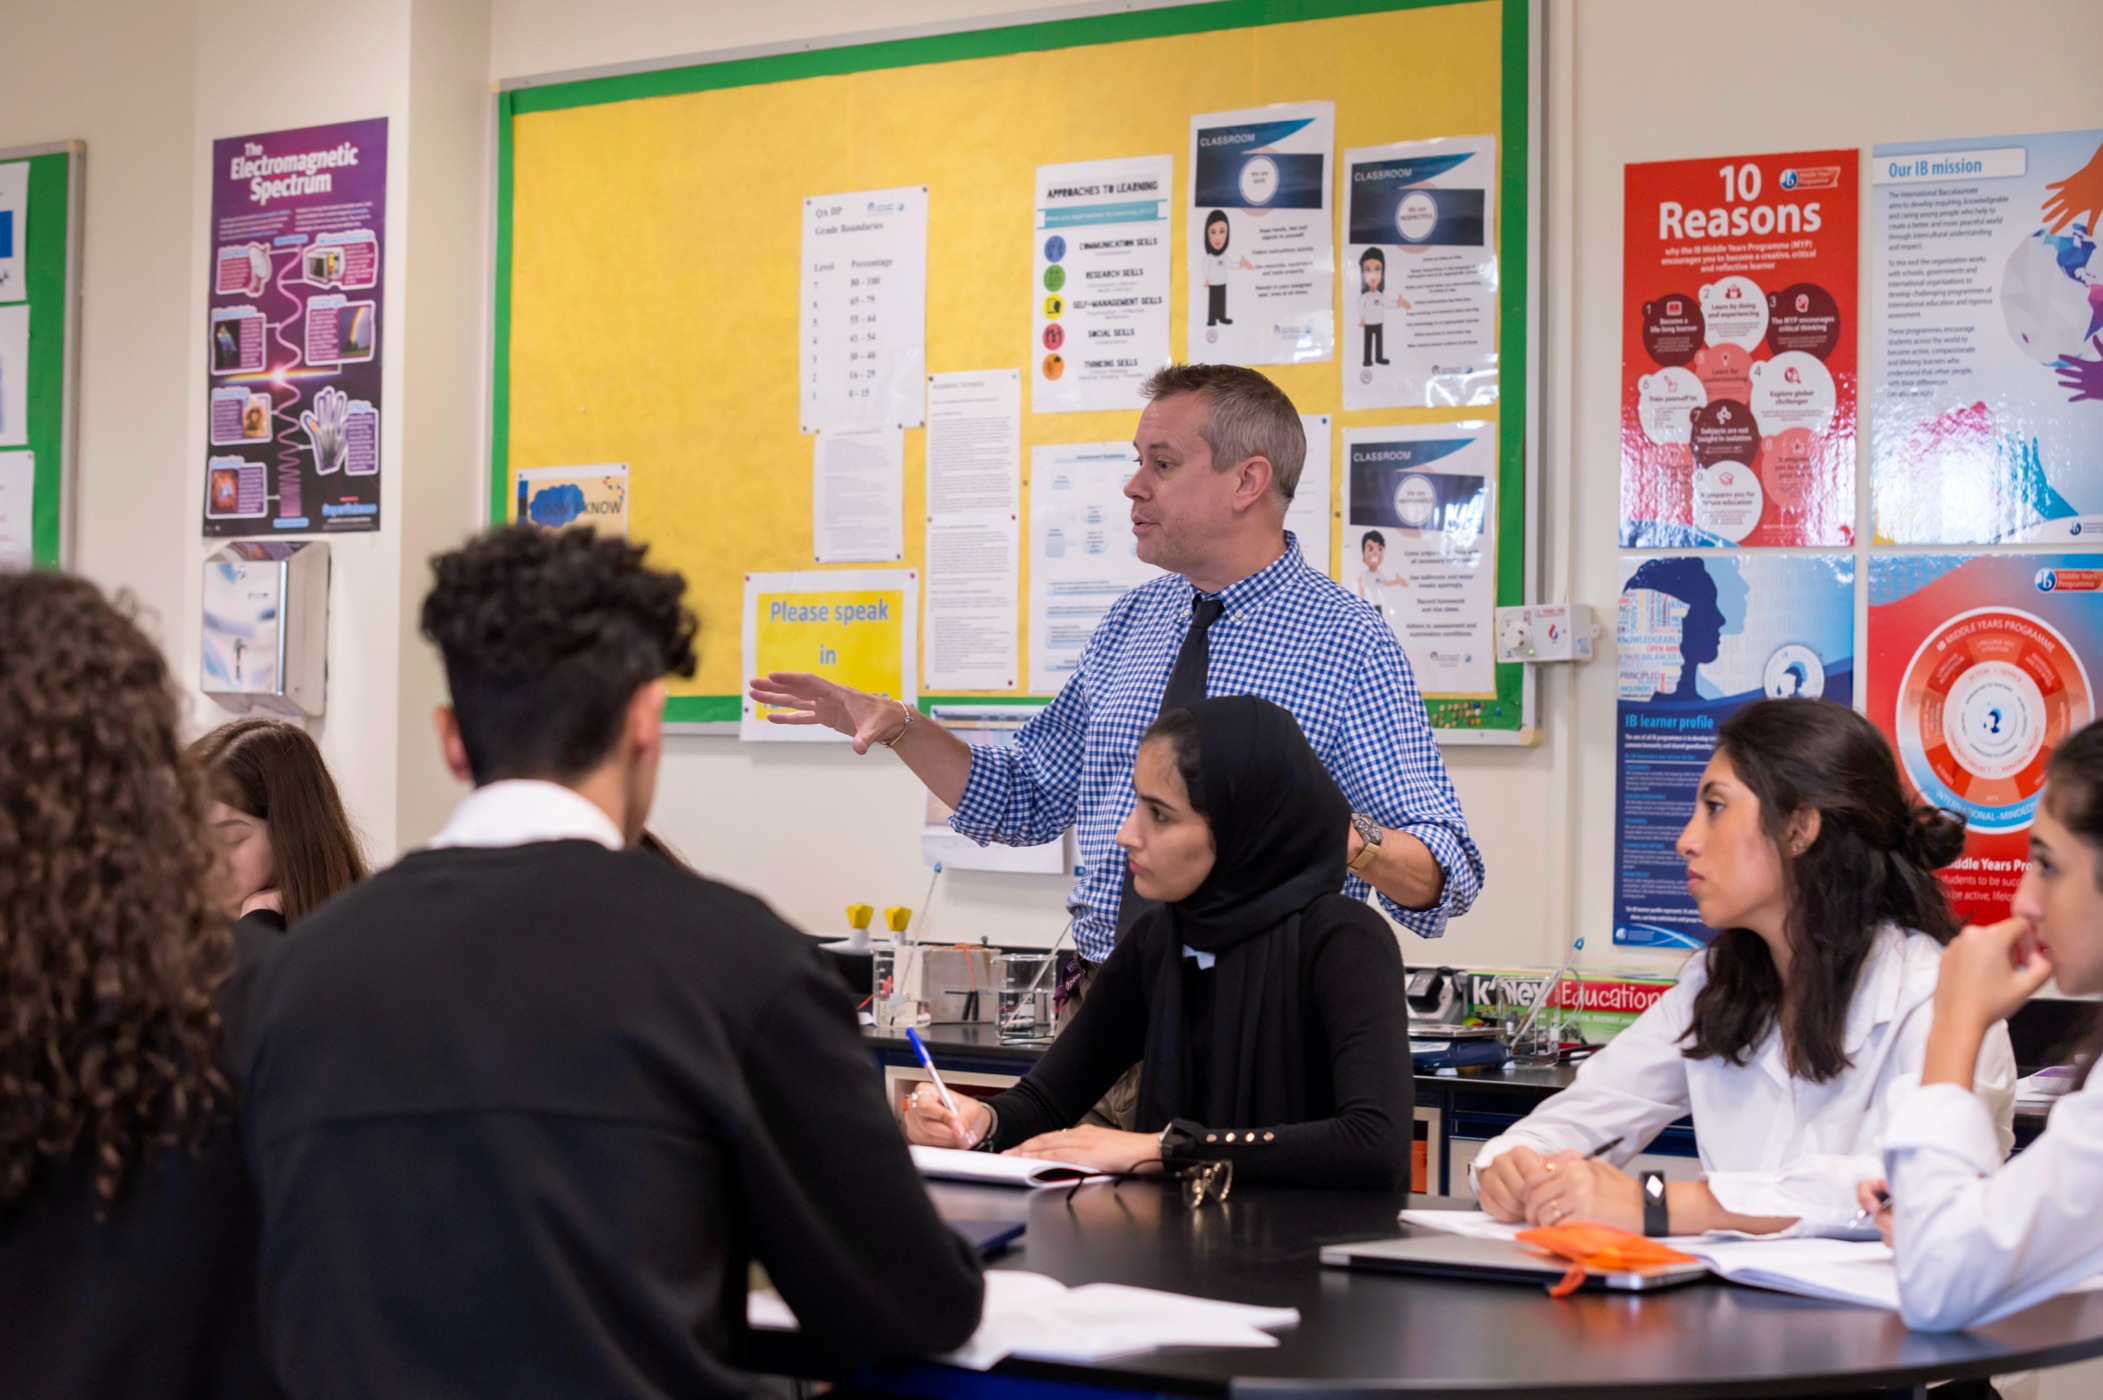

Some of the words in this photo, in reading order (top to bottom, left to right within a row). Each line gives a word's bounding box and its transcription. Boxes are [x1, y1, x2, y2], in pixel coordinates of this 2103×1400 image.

[1200, 133, 1256, 147] CLASSROOM
[245, 143, 264, 156] The
[230, 141, 359, 180] Electromagnetic
[1889, 163, 1911, 178] Our
[1916, 161, 1928, 176] IB
[1932, 158, 1982, 175] mission
[1354, 168, 1412, 182] CLASSROOM
[1719, 163, 1762, 203] 10
[250, 173, 332, 206] Spectrum
[1047, 185, 1100, 199] APPROACHES
[1103, 184, 1114, 194] TO
[1117, 181, 1158, 193] LEARNING
[1938, 188, 1978, 196] Baccalaureate
[1963, 196, 2009, 204] knowledgeable
[1901, 212, 1919, 220] caring
[1920, 211, 1938, 219] young
[1940, 209, 1959, 217] people
[1659, 201, 1822, 241] Reasons
[1960, 218, 1984, 227] peaceful
[815, 226, 838, 235] Grade
[841, 222, 884, 233] Boundaries
[1949, 229, 1992, 237] understanding
[1080, 239, 1134, 250] COMMUNICATION
[1137, 238, 1158, 246] SKILLS
[1665, 248, 1680, 256] why
[1681, 246, 1692, 254] the
[1702, 245, 1727, 253] Middle
[1728, 244, 1746, 252] Years
[1747, 242, 1790, 252] Programme
[1791, 240, 1813, 250] (MYP)
[1661, 257, 1701, 266] encourages
[1702, 256, 1716, 264] you
[1726, 253, 1754, 262] become
[1760, 251, 1791, 260] creative,
[1791, 249, 1817, 258] critical
[814, 262, 835, 272] Level
[851, 259, 893, 269] Percentage
[1700, 265, 1714, 273] and
[1715, 262, 1749, 272] reflective
[1749, 262, 1776, 270] learner
[1086, 270, 1120, 279] RESEARCH
[1123, 268, 1143, 277] SKILLS
[1703, 288, 1710, 299] 2
[1073, 298, 1138, 309] SELF-MANAGEMENT
[1141, 296, 1162, 305] SKILLS
[1711, 303, 1729, 311] Learn
[1730, 303, 1738, 312] by
[1738, 303, 1756, 311] doing
[1770, 296, 1777, 308] 3
[1721, 310, 1760, 319] experiencing
[1659, 317, 1683, 326] Become
[1772, 317, 1783, 325] The
[1783, 317, 1798, 325] MYP
[1798, 316, 1835, 325] encourages
[1088, 329, 1111, 338] SOCIAL
[1114, 328, 1135, 336] SKILLS
[1676, 324, 1698, 333] learner
[1779, 325, 1800, 333] critical
[1800, 324, 1827, 333] thinking
[1084, 360, 1114, 368] THINKING
[1117, 359, 1138, 367] SKILLS
[1754, 366, 1761, 377] 4
[1642, 380, 1650, 390] 6
[1703, 376, 1748, 384] understanding
[1665, 395, 1688, 403] yourself
[1770, 391, 1793, 399] Explore
[1794, 390, 1814, 398] global
[1775, 398, 1808, 406] challenges
[1693, 410, 1701, 422] 7
[1700, 427, 1728, 436] Subjects
[1726, 434, 1752, 442] isolation
[1353, 451, 1412, 462] CLASSROOM
[1722, 498, 1753, 506] education
[2058, 572, 2080, 580] Middle
[2058, 580, 2095, 589] Programme
[771, 601, 829, 622] Please
[835, 598, 889, 627] speak
[1946, 622, 1976, 643] MIDDLE
[1977, 619, 2002, 629] YEARS
[2005, 620, 2056, 652] PROGRAMME
[820, 644, 837, 665] in
[1620, 671, 1660, 679] PRINCIPLED
[1625, 713, 1638, 728] IB
[1640, 713, 1677, 728] learner
[1679, 714, 1714, 732] profile
[1981, 858, 2011, 871] Years
[1978, 876, 1987, 885] to
[1989, 876, 2000, 885] be
[1964, 891, 1991, 901] active,
[1561, 981, 1661, 1009] Education
